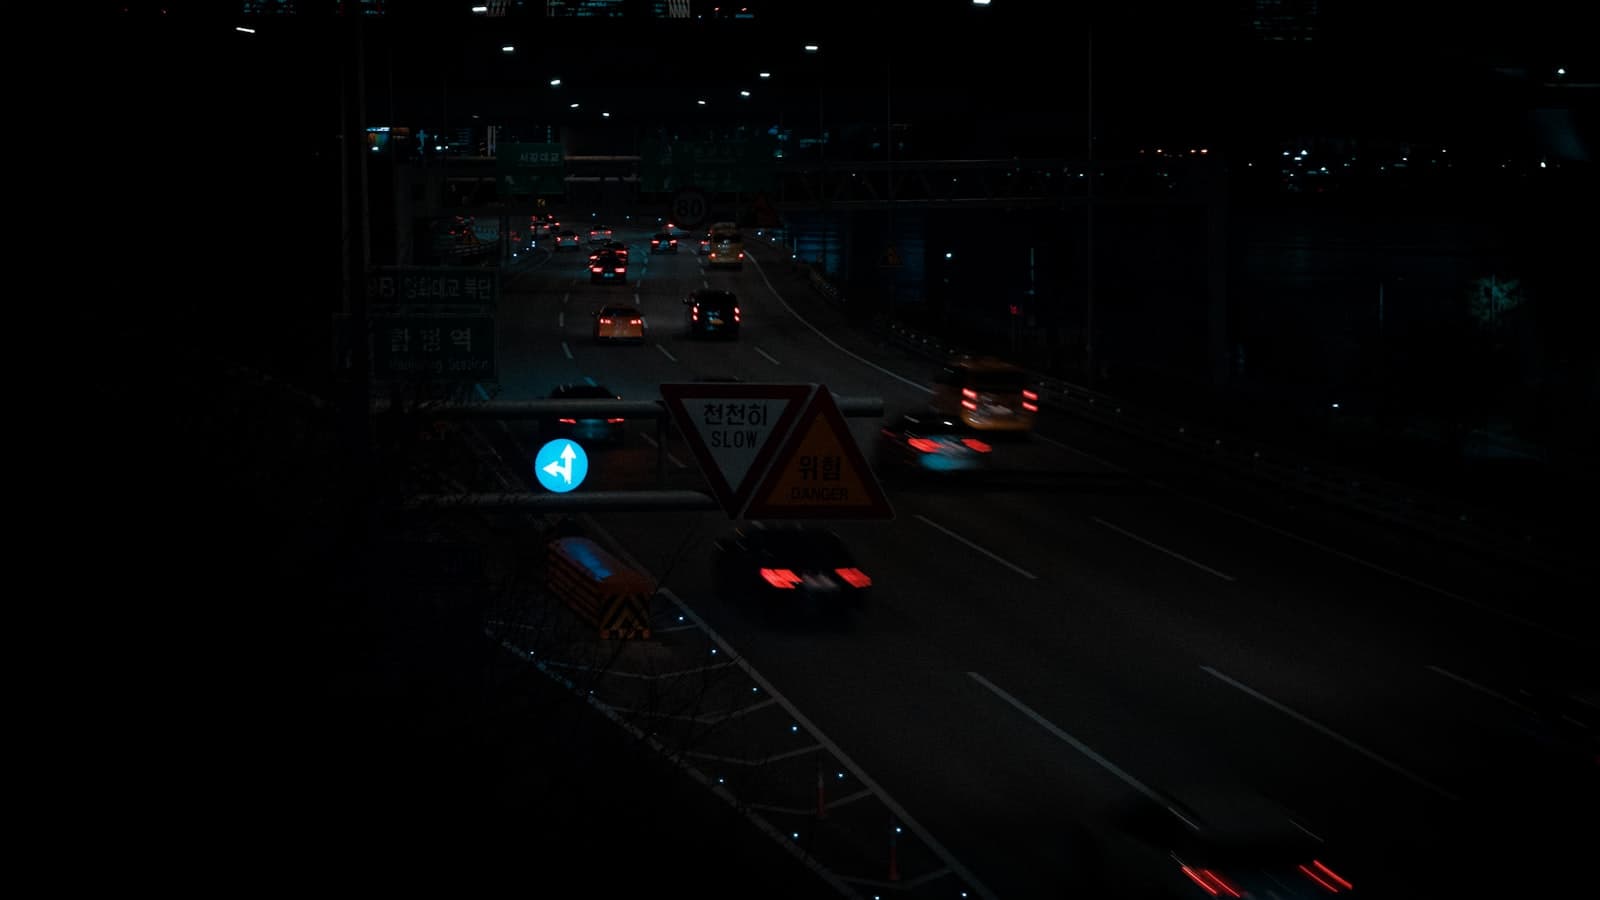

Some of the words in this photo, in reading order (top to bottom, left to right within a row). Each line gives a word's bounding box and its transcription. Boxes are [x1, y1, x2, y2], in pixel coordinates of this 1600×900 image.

[677, 199, 703, 217] 80
[704, 403, 768, 426] 천천히
[711, 430, 758, 448] SLOW
[800, 455, 841, 481] 위험
[791, 487, 849, 500] DANGER
